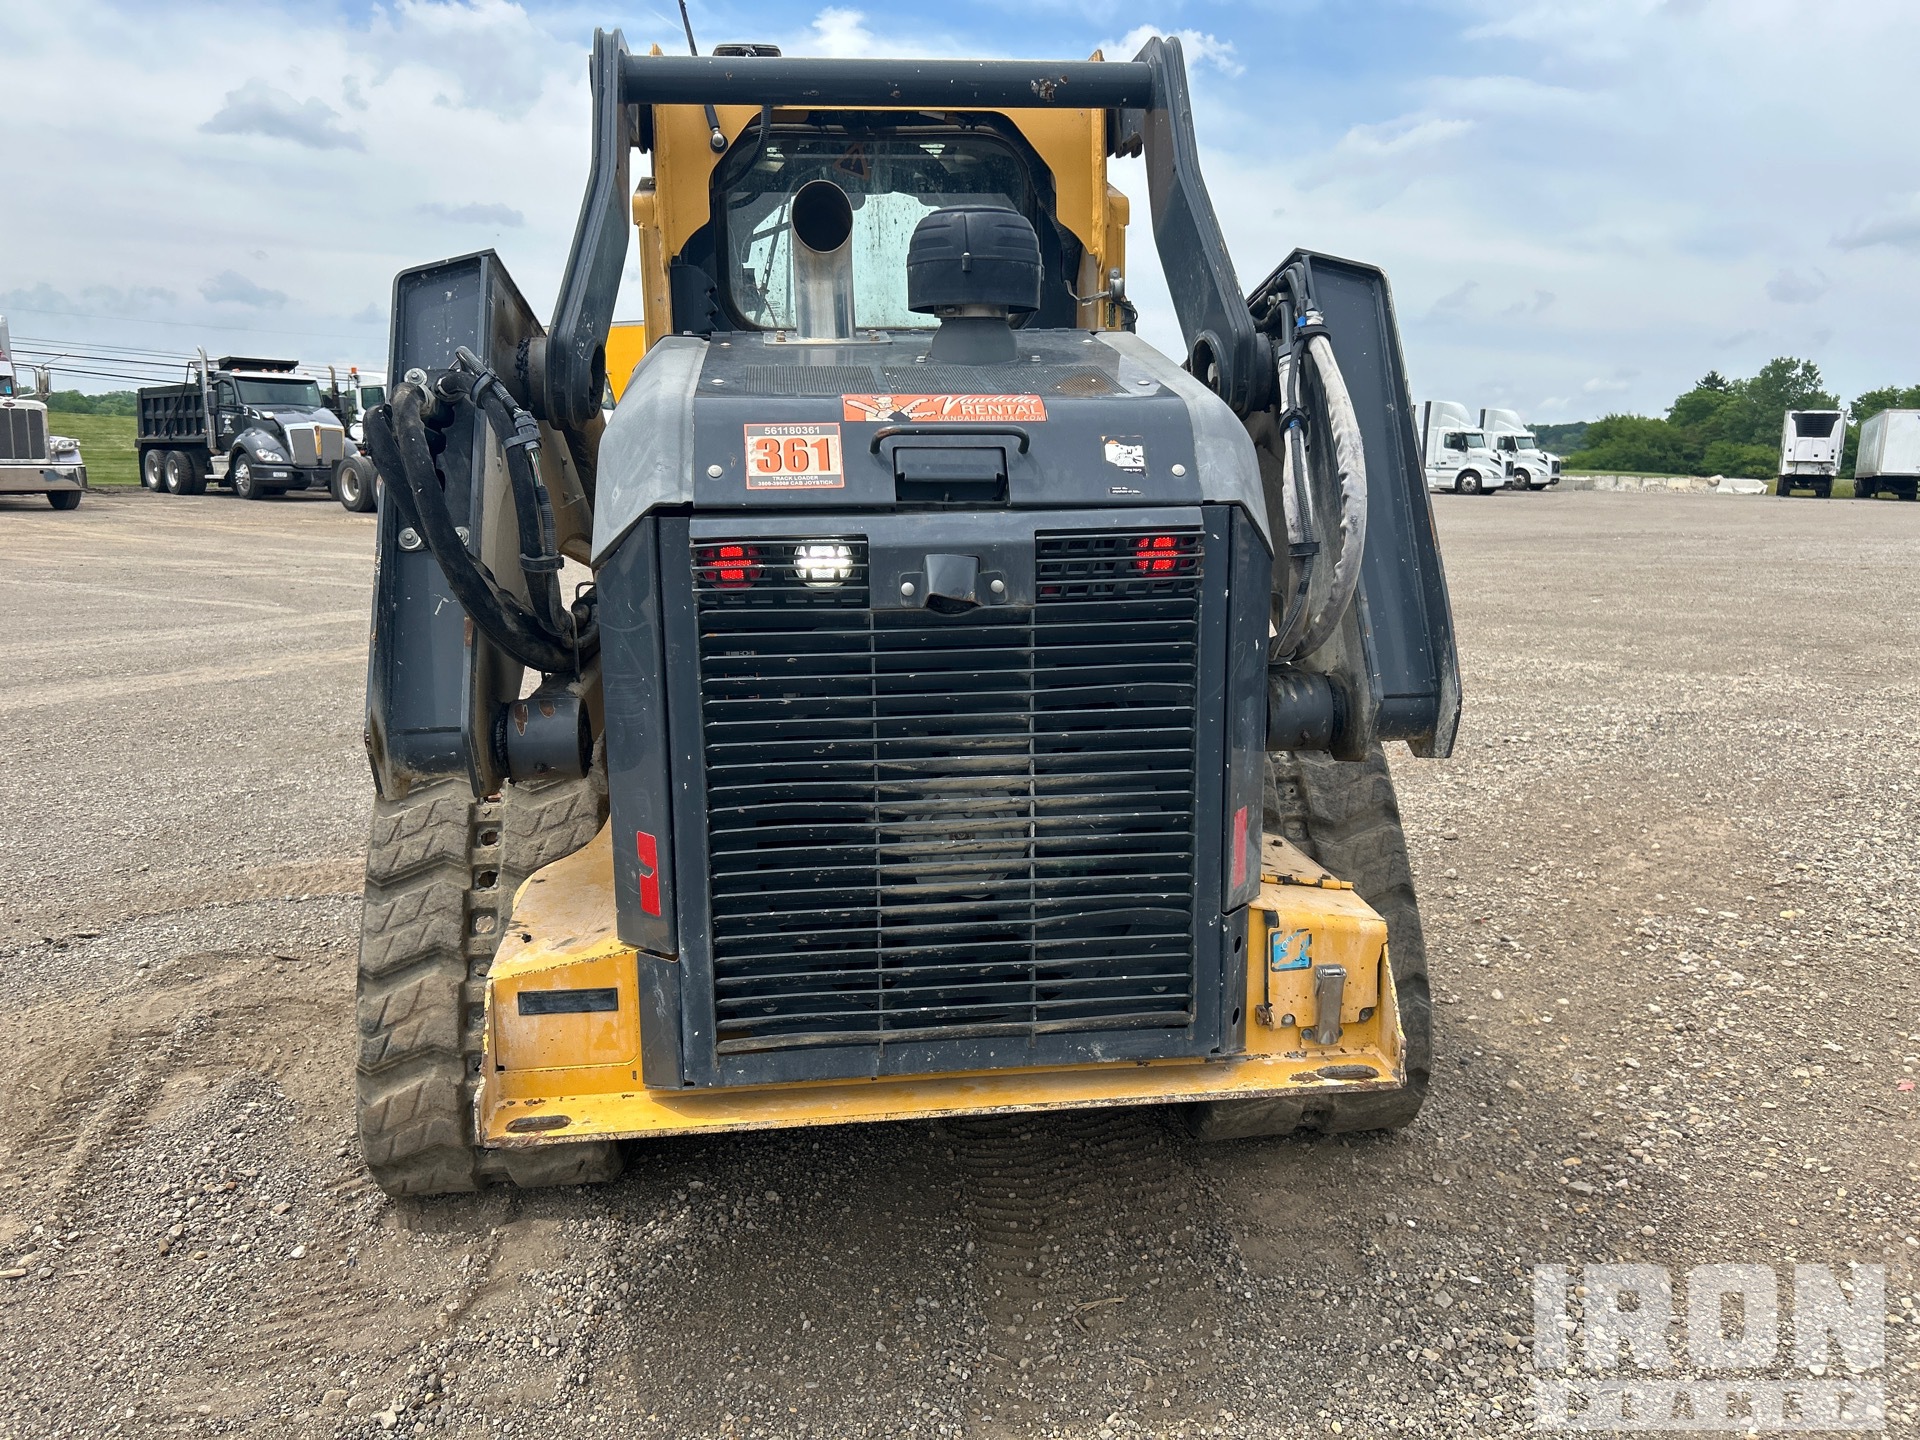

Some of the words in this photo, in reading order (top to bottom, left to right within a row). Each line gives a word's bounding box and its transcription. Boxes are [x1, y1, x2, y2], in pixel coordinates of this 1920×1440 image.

[933, 395, 1039, 415] Vandalia
[961, 404, 1041, 415] RENTAL
[764, 426, 820, 435] 561180361
[755, 437, 831, 473] 361
